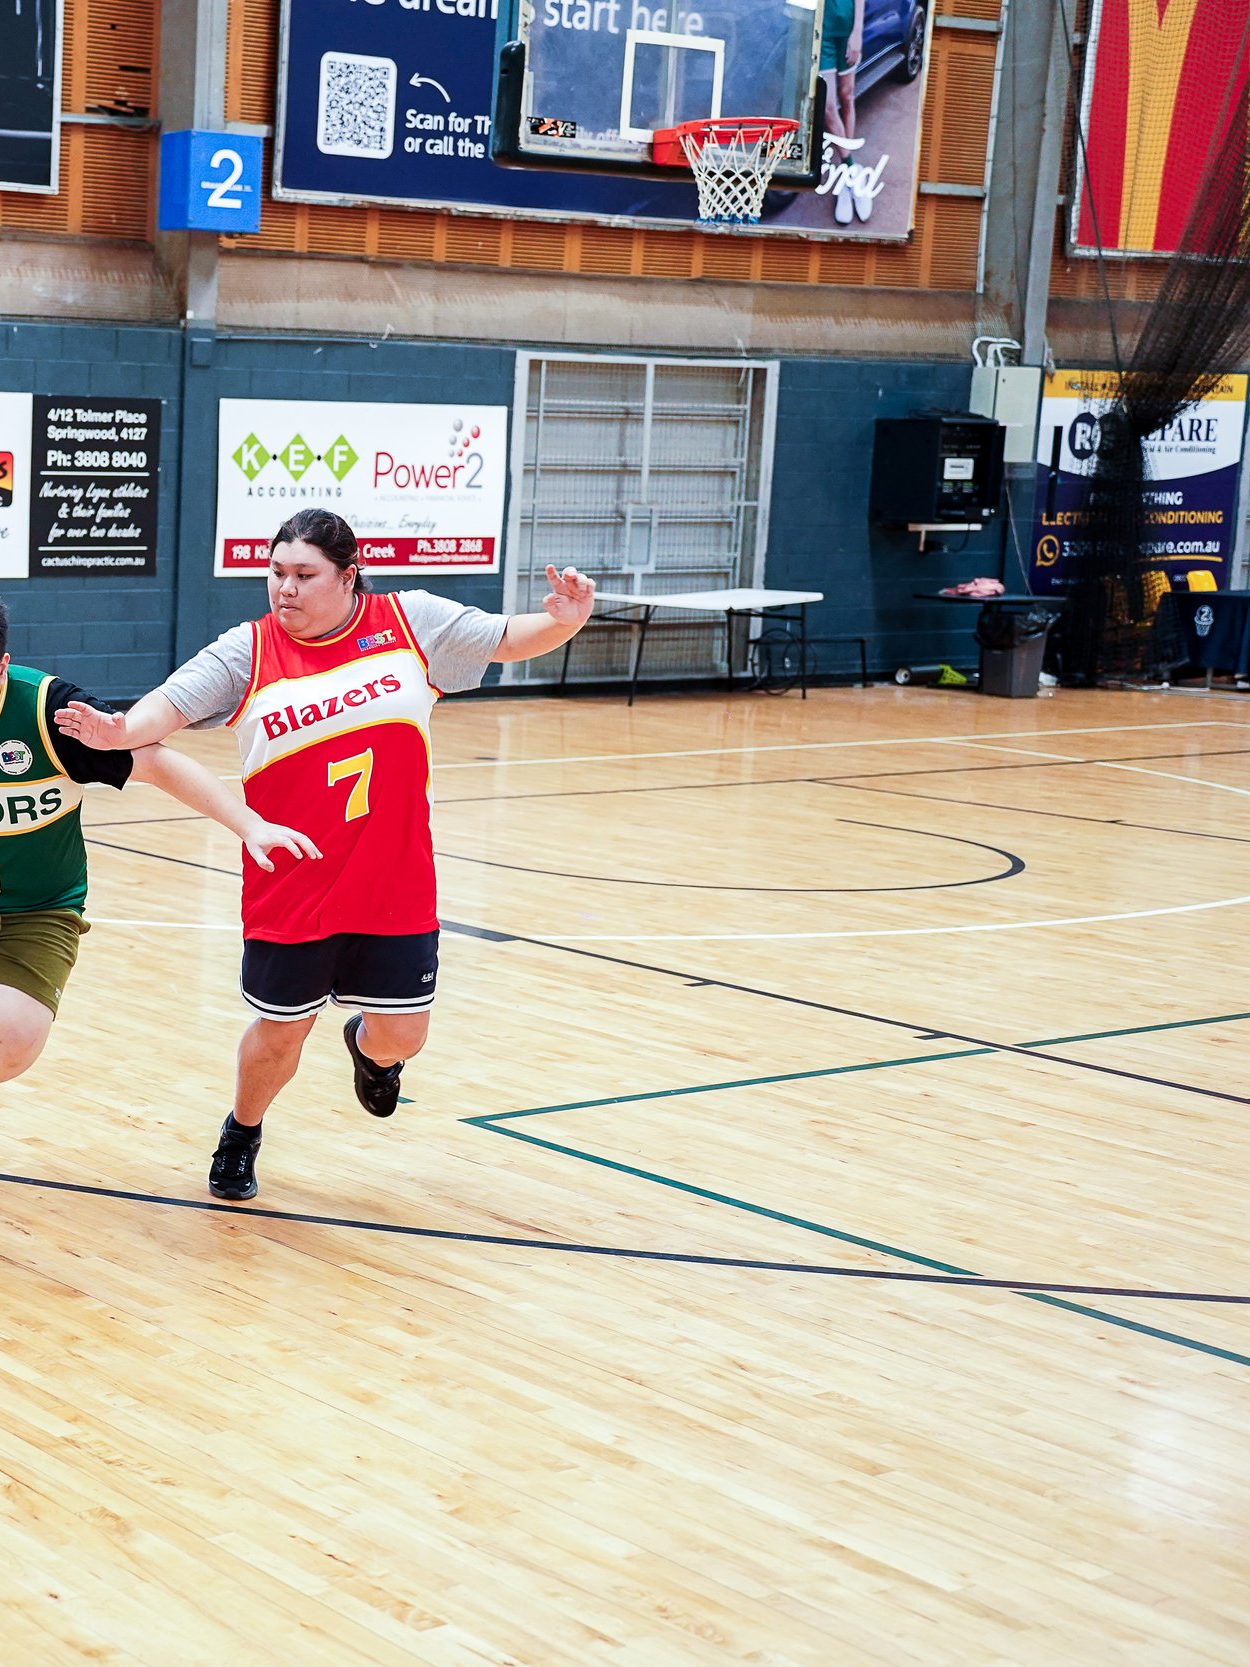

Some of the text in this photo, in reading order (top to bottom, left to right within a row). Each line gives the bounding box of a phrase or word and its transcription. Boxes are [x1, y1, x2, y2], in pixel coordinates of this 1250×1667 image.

[405, 108, 444, 131] Scan
[448, 112, 472, 134] for
[404, 135, 485, 159] or call the
[207, 148, 244, 209] 2
[47, 408, 73, 421] 4/12
[115, 409, 147, 423] Place
[47, 425, 148, 442] Springwood, 4127
[47, 450, 147, 468] Ph: 3808 8040
[374, 452, 483, 488] Power2
[248, 487, 342, 497] ACCOUNTING
[58, 502, 70, 518] &
[232, 544, 252, 560] 198
[363, 543, 396, 558] Creek
[261, 674, 401, 741] Blazers
[1, 750, 26, 763] BEST
[327, 747, 374, 823] 7
